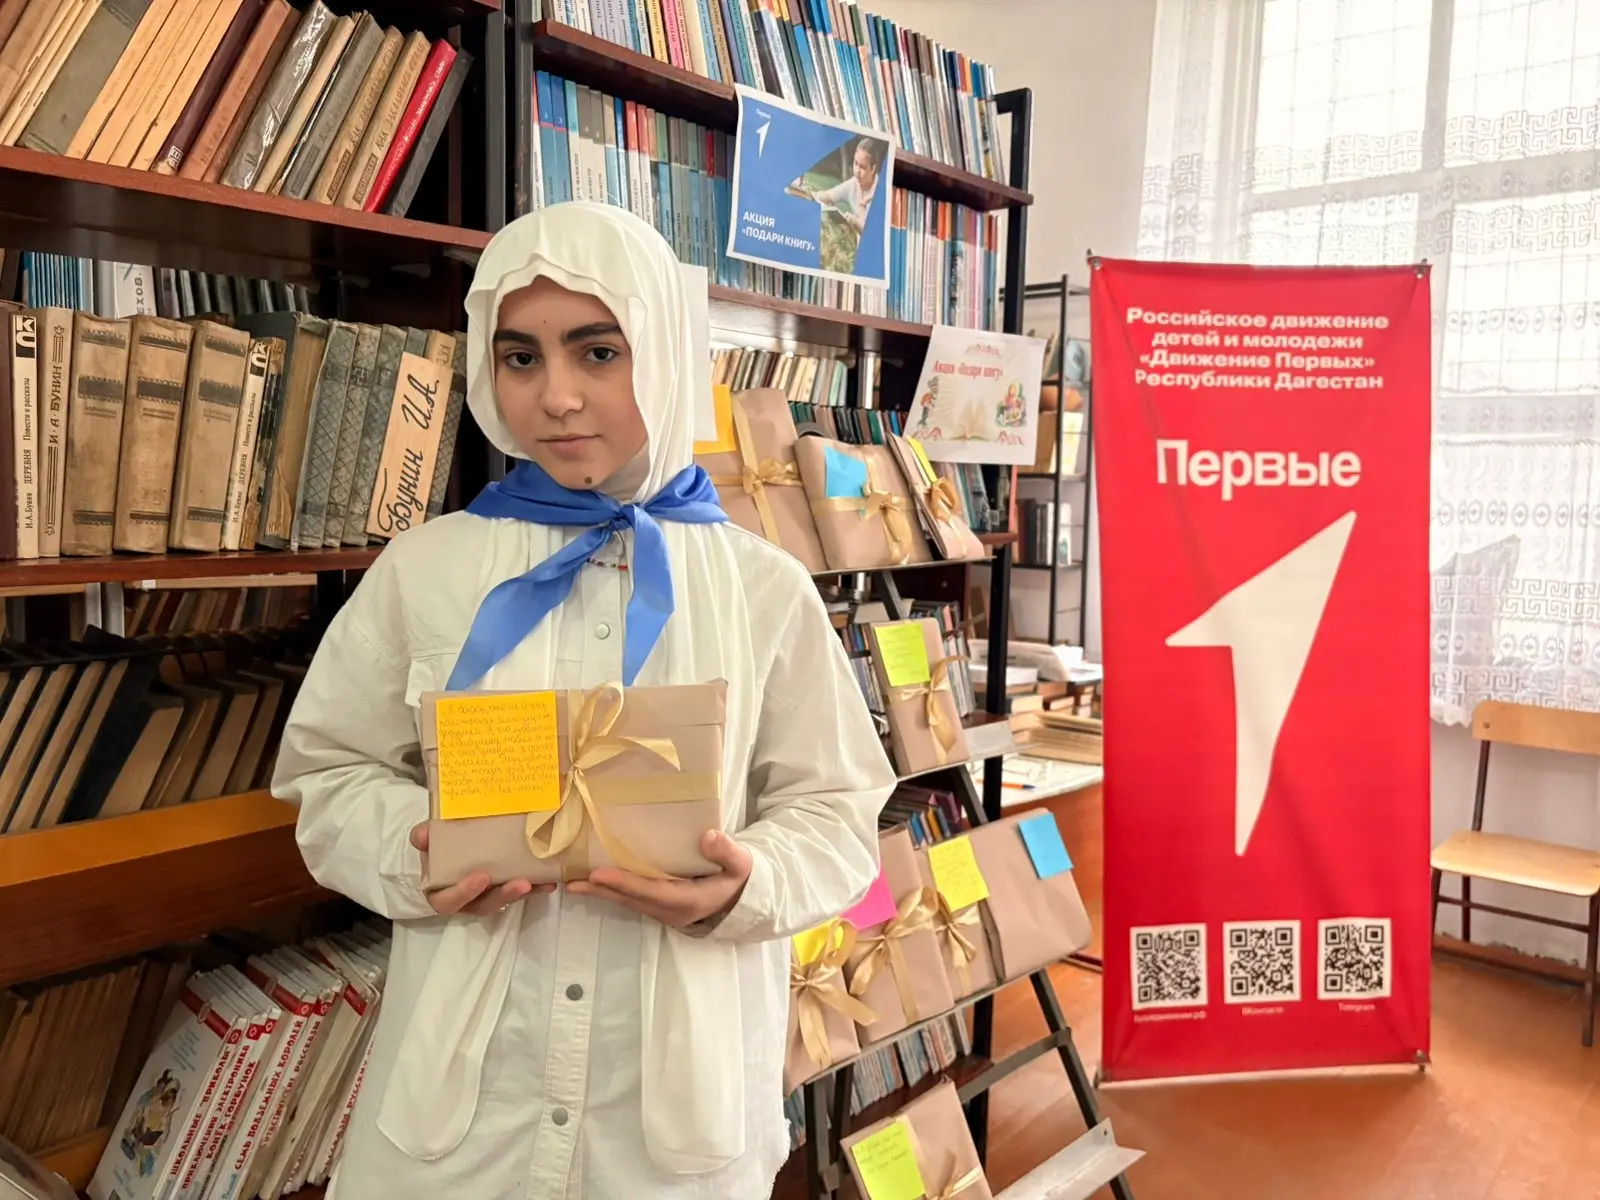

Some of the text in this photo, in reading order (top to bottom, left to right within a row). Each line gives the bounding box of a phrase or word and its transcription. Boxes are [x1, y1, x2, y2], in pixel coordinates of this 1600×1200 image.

[742, 211, 775, 229] АКЦИЯ
[741, 226, 784, 245] «ПОДАРИ
[1126, 307, 1389, 329] Российское движение
[1151, 330, 1363, 350] детей и молодежи
[1140, 350, 1375, 371] «Движение Первых»
[1135, 369, 1383, 391] Республики Дагестан
[23, 408, 31, 441] Повести
[376, 373, 440, 532] Бунин И.А.
[23, 448, 32, 486] ДЕРЕВНЯ
[1156, 438, 1361, 501] Первые
[293, 1020, 321, 1073] РАССКАЗЫ
[234, 1018, 304, 1171] СЕМЬ ПОДЗЕМНЫХ КОРОЛЕЙ
